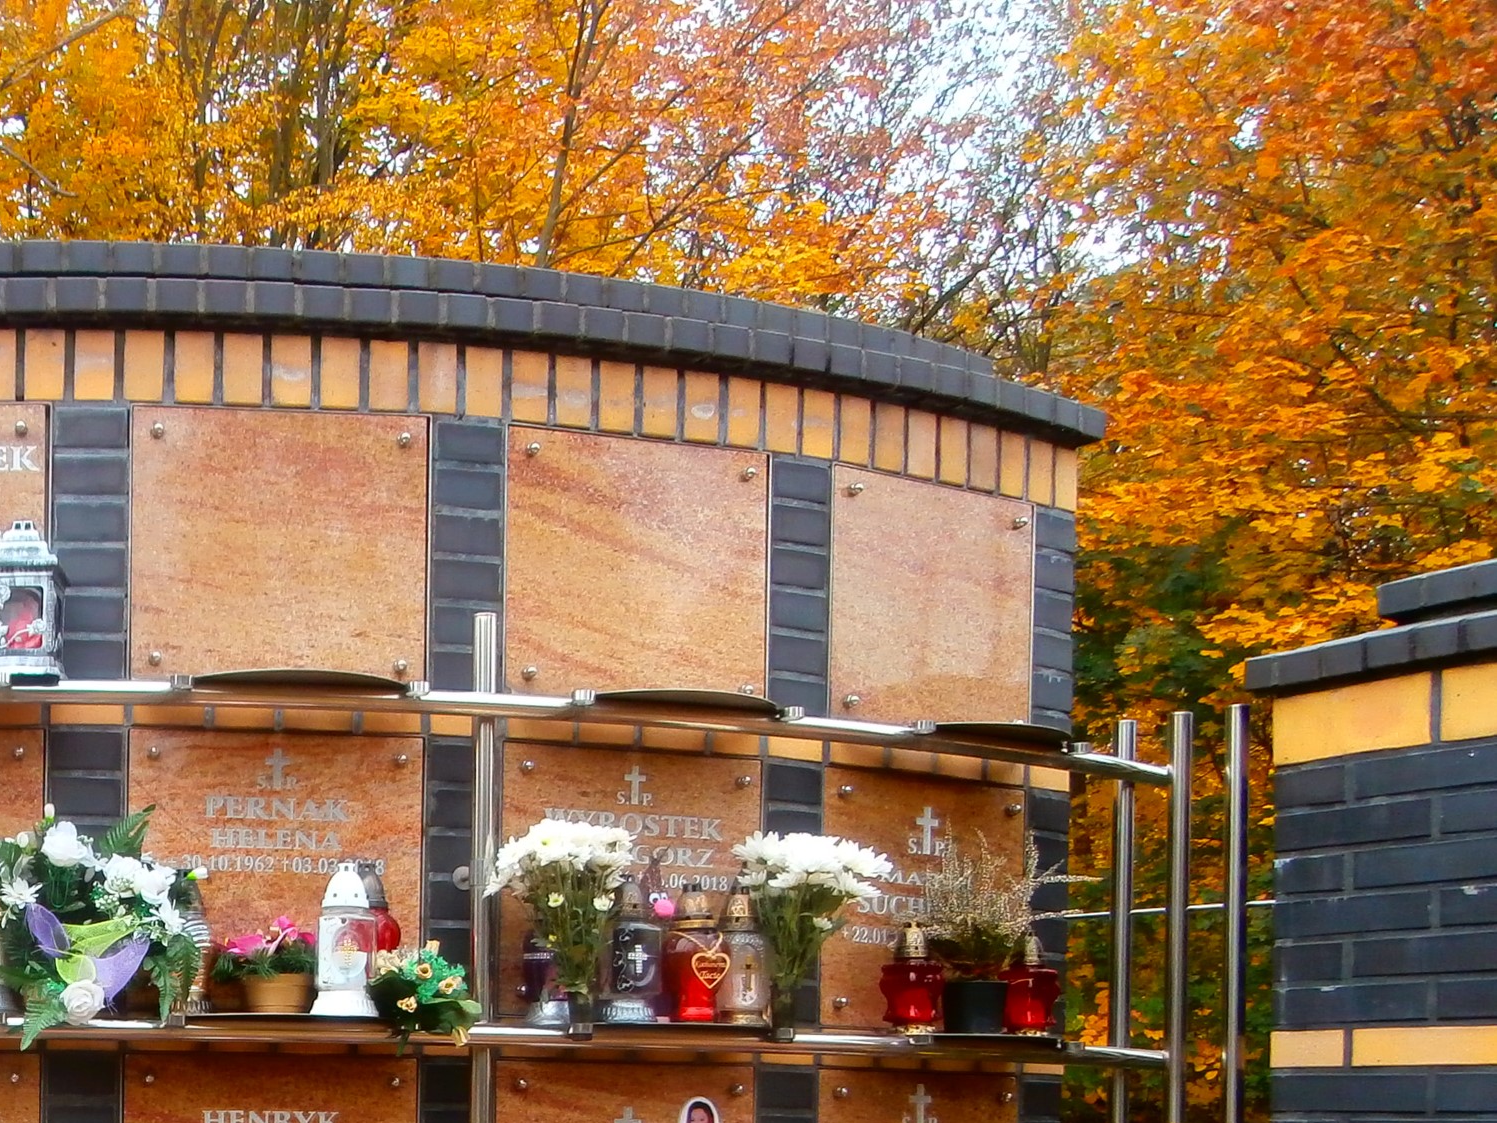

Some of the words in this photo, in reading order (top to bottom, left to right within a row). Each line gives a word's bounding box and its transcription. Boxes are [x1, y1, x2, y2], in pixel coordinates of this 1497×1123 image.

[204, 794, 350, 822] PERNAK
[210, 827, 342, 851] HELENA
[182, 854, 274, 873] 3010.1962
